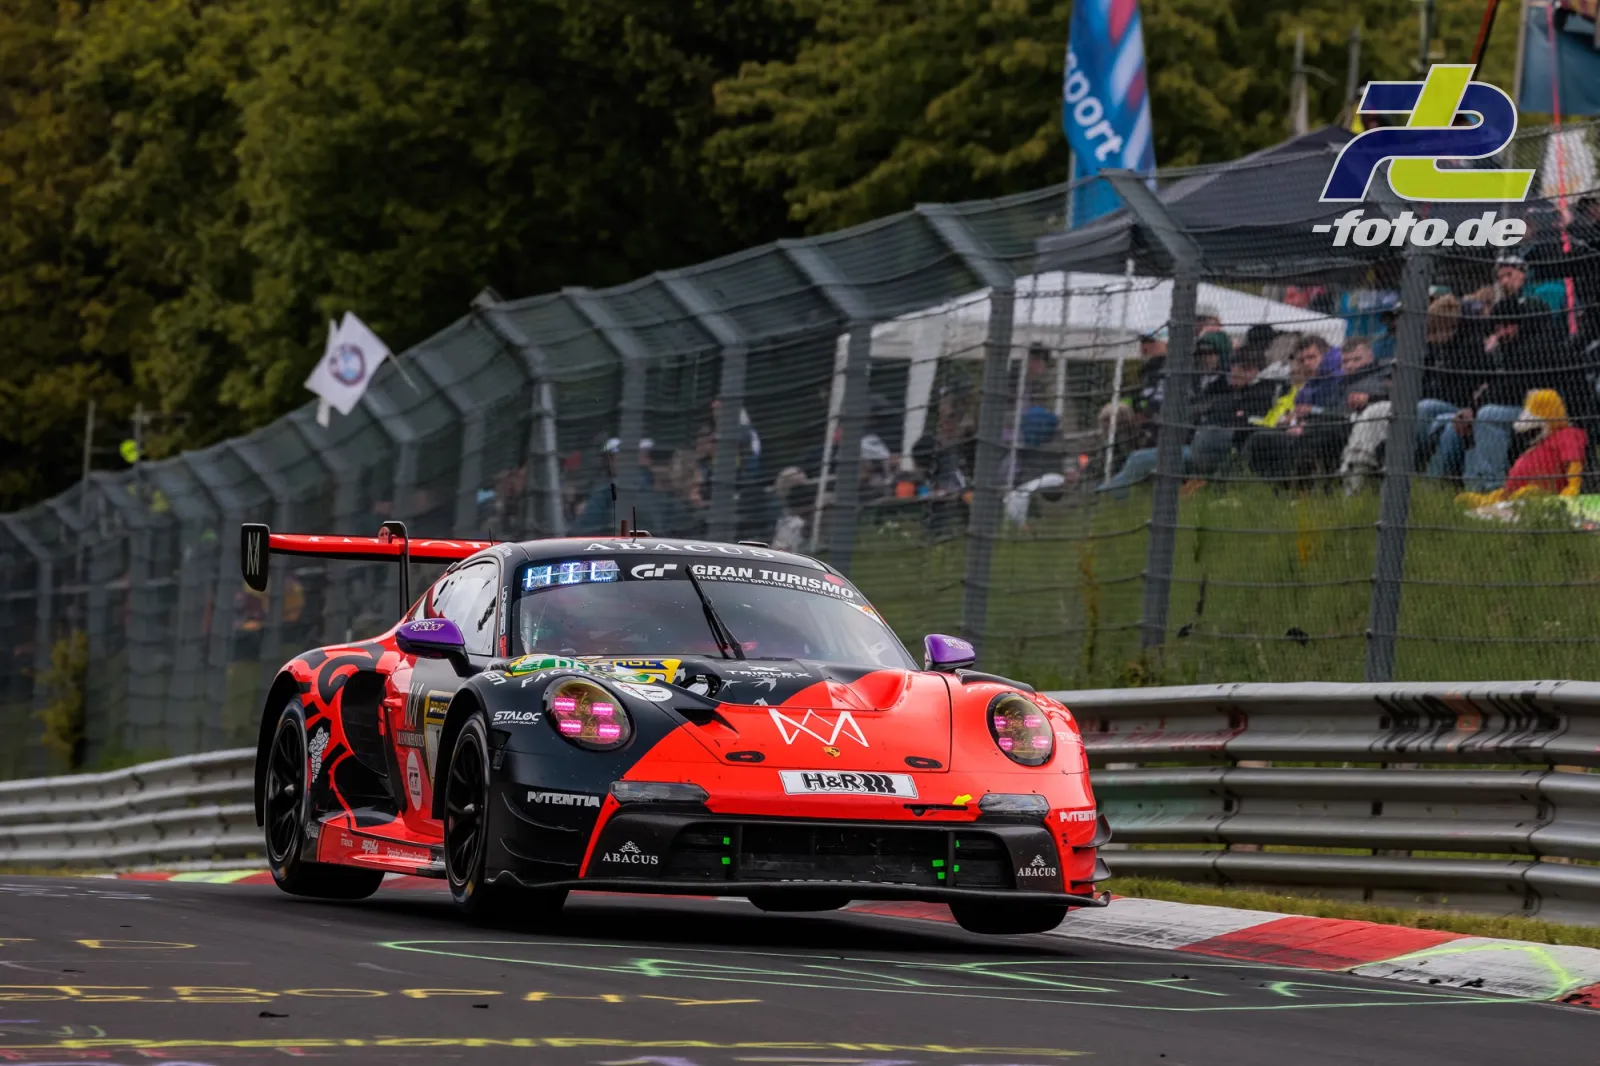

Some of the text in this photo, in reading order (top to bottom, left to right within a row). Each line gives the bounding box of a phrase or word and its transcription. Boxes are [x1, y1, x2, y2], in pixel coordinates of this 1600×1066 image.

[583, 542, 774, 558] ABACUS
[691, 564, 854, 598] GRAN TURISMO
[751, 578, 794, 589] DRIVING
[796, 585, 856, 603] SIMULATOR
[493, 711, 542, 721] STALOC
[801, 772, 896, 793] H&R
[527, 791, 600, 807] POTENTIA
[602, 852, 658, 864] ABACUS
[1017, 867, 1056, 877] ABACUS
[0, 985, 763, 1006] TROPHY
